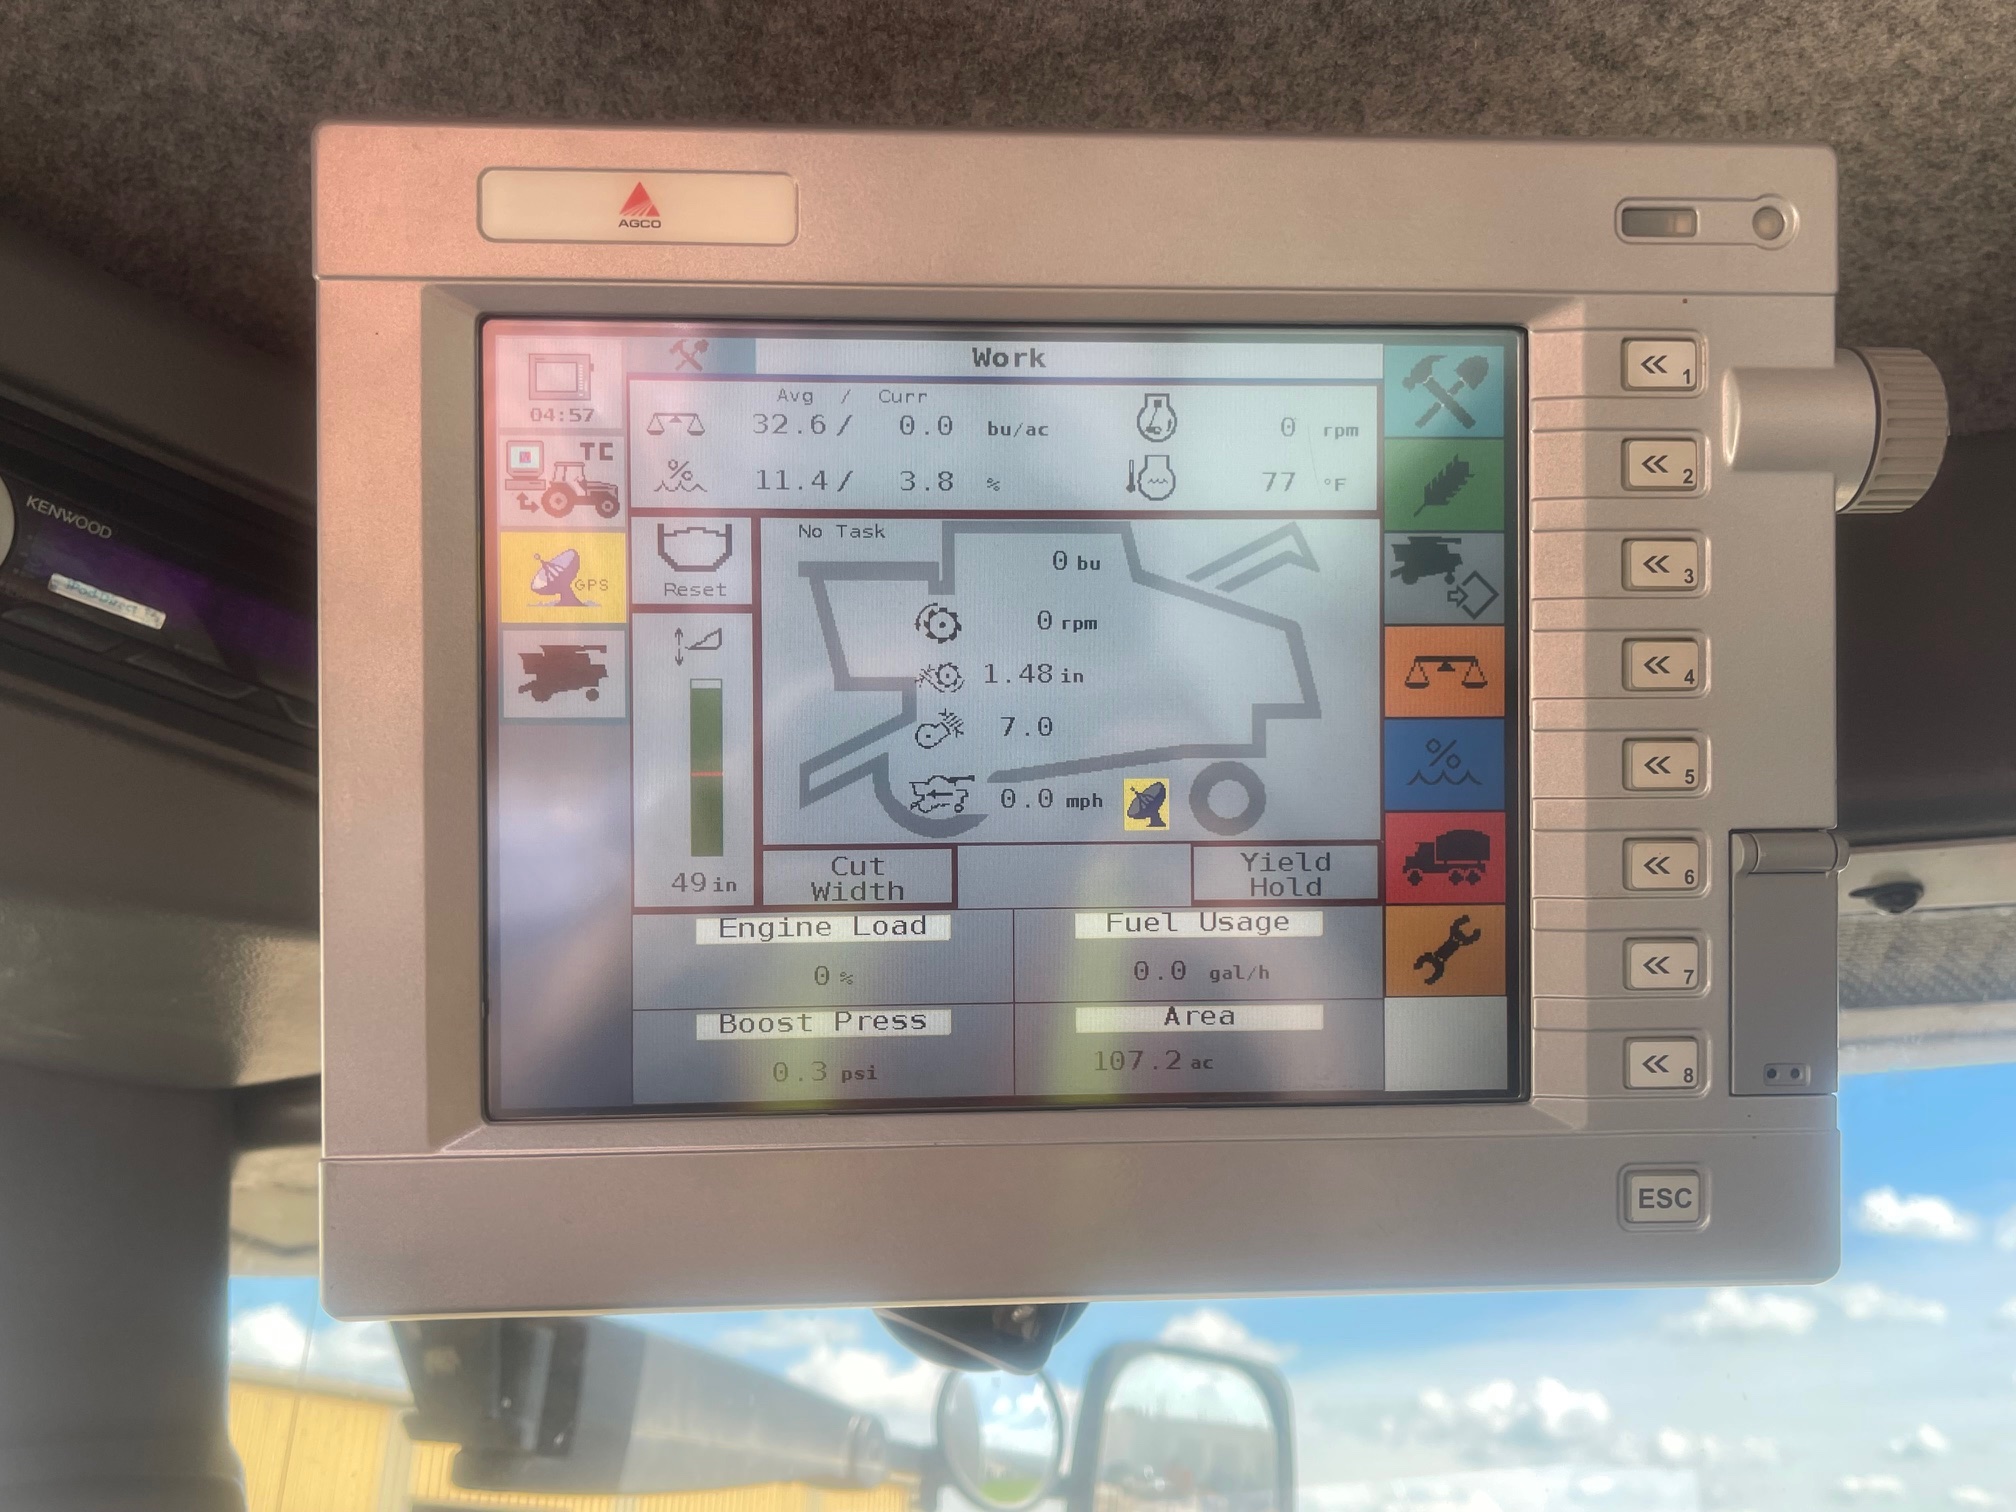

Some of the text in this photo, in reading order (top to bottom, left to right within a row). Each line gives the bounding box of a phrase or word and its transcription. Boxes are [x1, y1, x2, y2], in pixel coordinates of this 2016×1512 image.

[618, 219, 662, 228] AGCO
[971, 346, 1047, 368] Work
[1682, 369, 1691, 384] 1
[777, 388, 814, 405] Avg
[878, 389, 928, 404] Curr
[530, 407, 595, 422] 04:57
[900, 414, 953, 436] 0.0
[987, 420, 1049, 438] bu/ac
[1280, 416, 1360, 440] 0 rpm
[579, 442, 614, 461] TC
[900, 470, 954, 492] 3.8
[986, 477, 1001, 492] %
[1262, 471, 1347, 492] 77 °F
[1682, 468, 1693, 484] 2
[26, 495, 112, 539] KENWOOD
[798, 524, 886, 539] No Task
[575, 579, 609, 592] GPS
[1684, 569, 1694, 584] 3
[664, 583, 727, 598] Reset
[1684, 669, 1695, 684] 4
[1000, 716, 1053, 736] 7.0
[1684, 769, 1695, 785] 5
[1000, 788, 1103, 811] 0.0 mph
[831, 856, 885, 876] Cut
[1239, 852, 1331, 872] Yield
[1250, 877, 1322, 897] Hold
[1684, 869, 1695, 885] 6
[810, 880, 905, 902] Width
[719, 915, 927, 942] Engine Load
[1106, 911, 1290, 935] Fuel Usage
[1133, 960, 1270, 983] 0.0 gal/h
[1683, 970, 1694, 985] 7
[719, 1009, 928, 1034] Boost Press
[1164, 1006, 1235, 1026] Area
[1095, 1050, 1182, 1071] 107.2
[772, 1062, 878, 1084] 0.3 psi
[1683, 1068, 1693, 1083] 8
[1638, 1188, 1693, 1209] ESC
